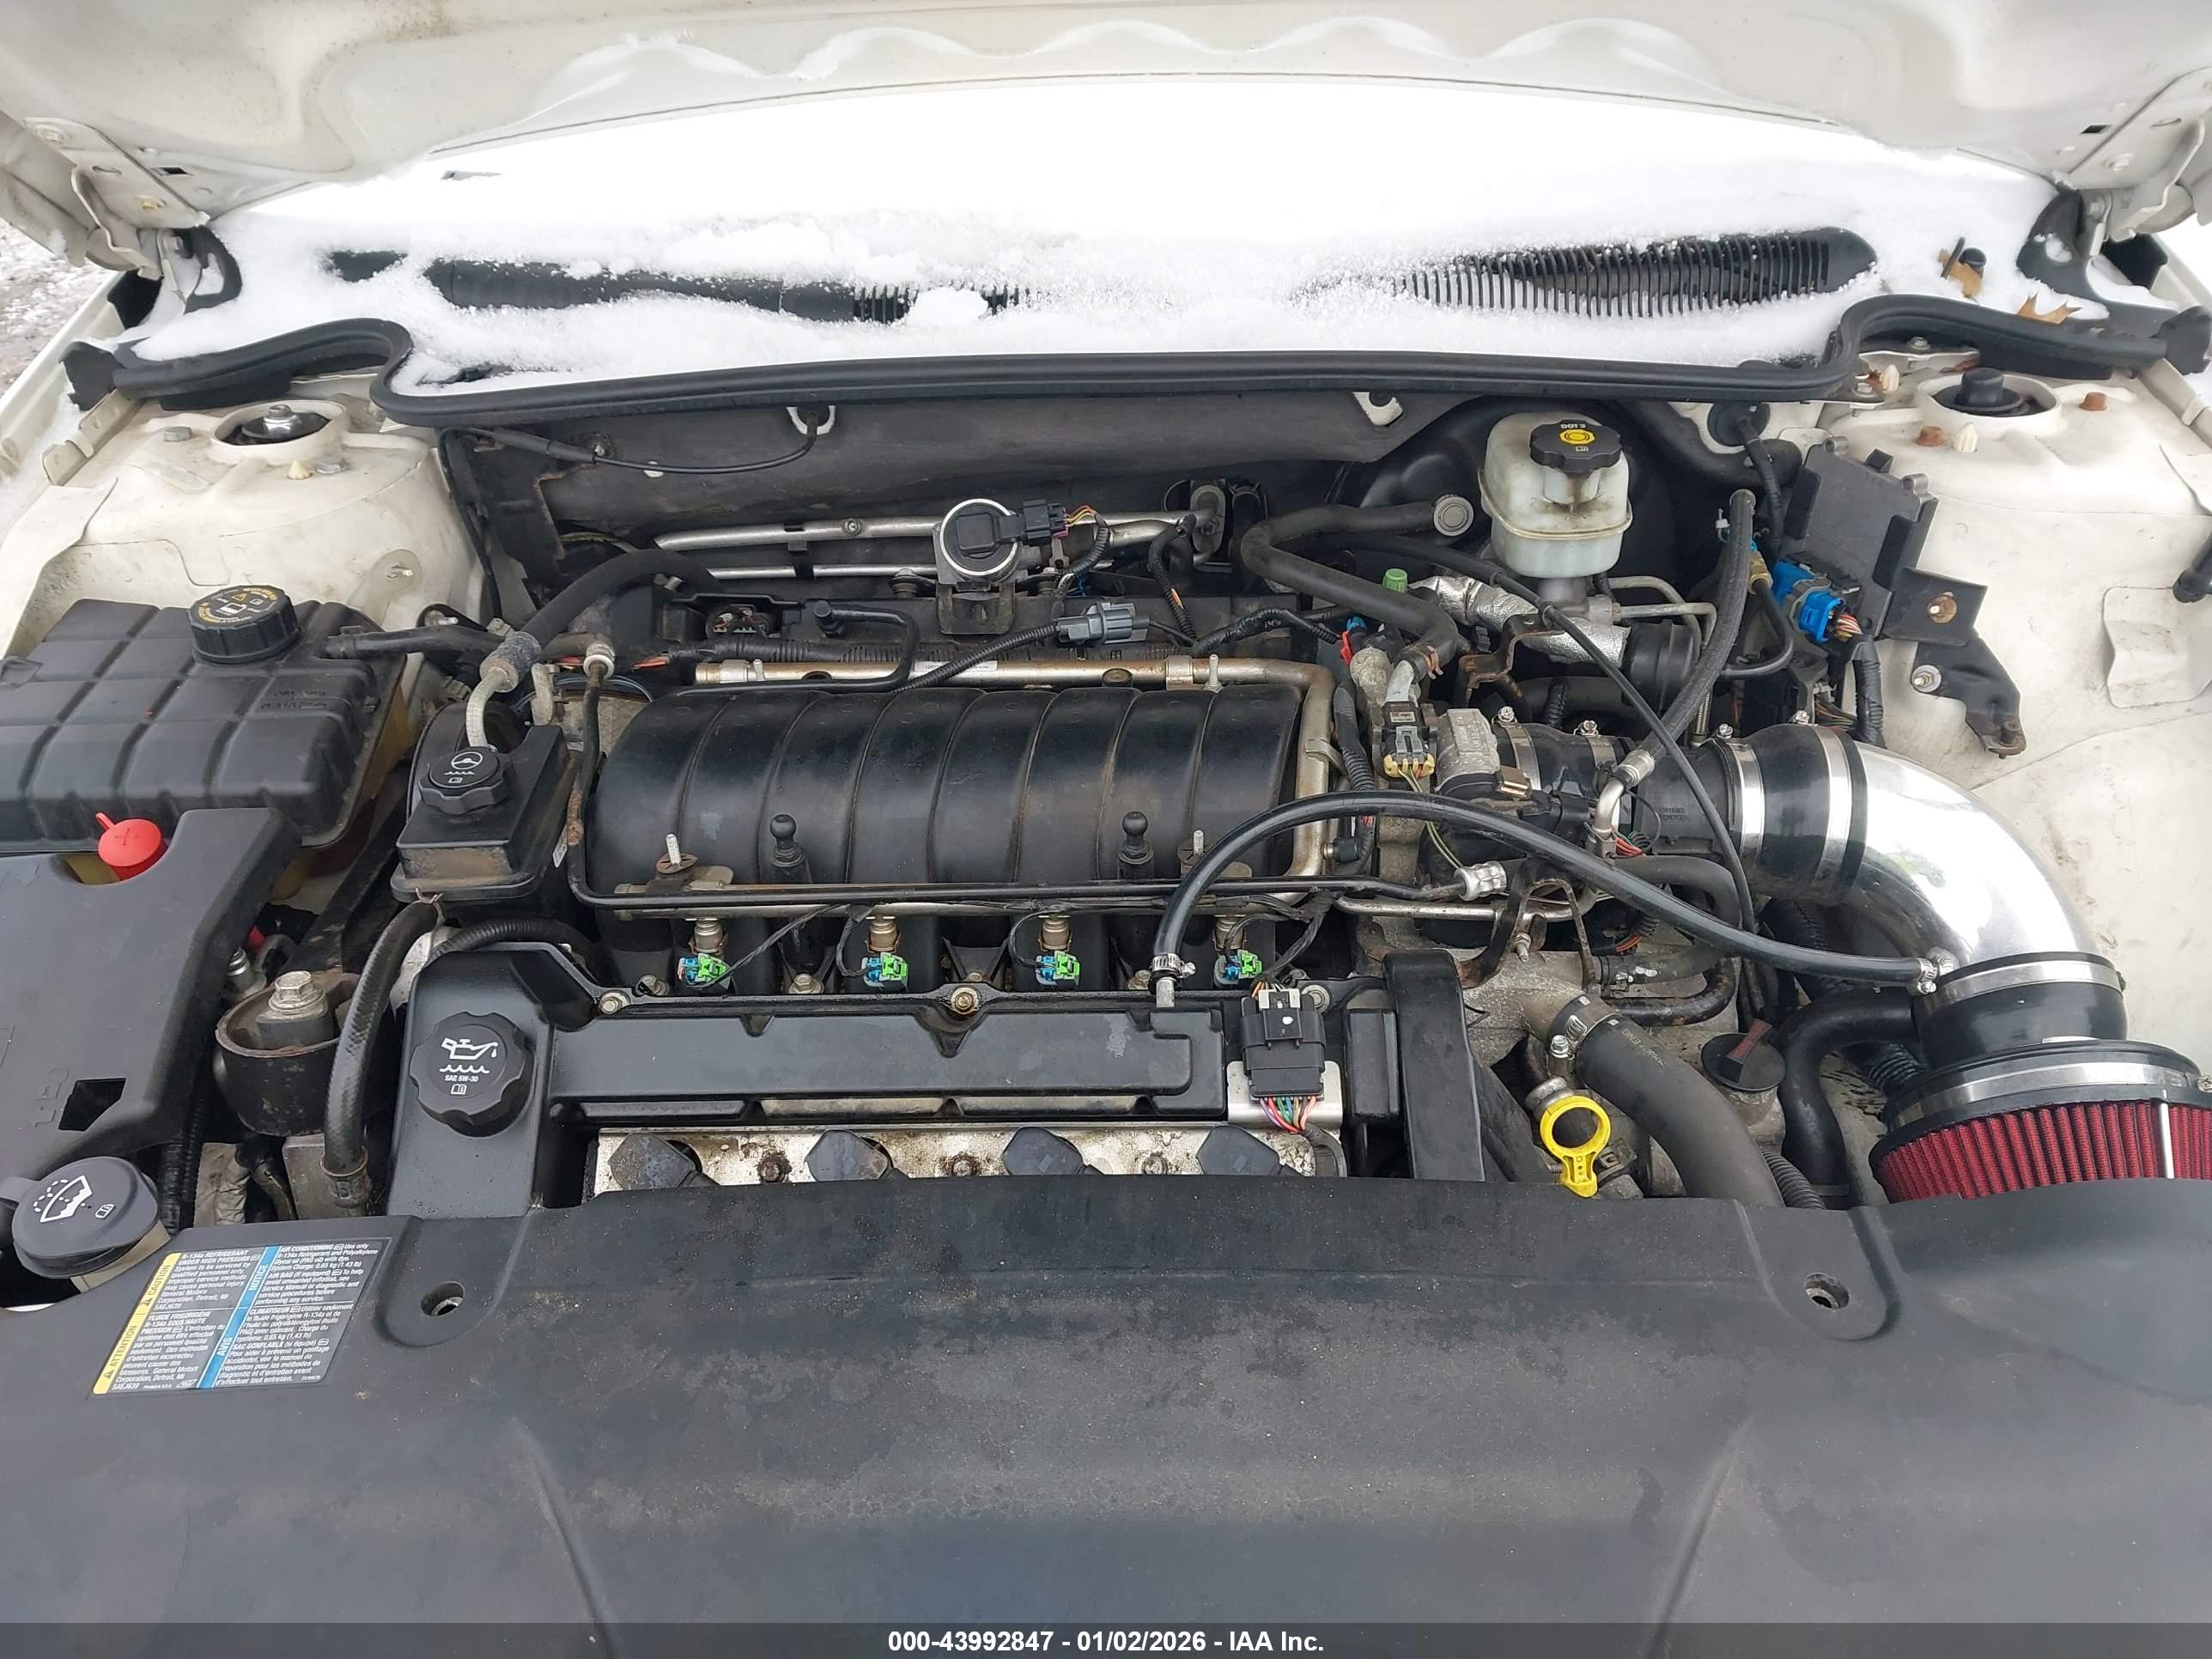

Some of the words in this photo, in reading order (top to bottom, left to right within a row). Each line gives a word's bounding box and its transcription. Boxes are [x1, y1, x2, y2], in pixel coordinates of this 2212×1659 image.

[1621, 1029, 1642, 1045] ENG
[149, 1265, 171, 1295] CAUTION
[248, 1265, 268, 1291] NOTICE
[110, 1326, 137, 1367] ATTENTION
[216, 1337, 233, 1357] AVIS
